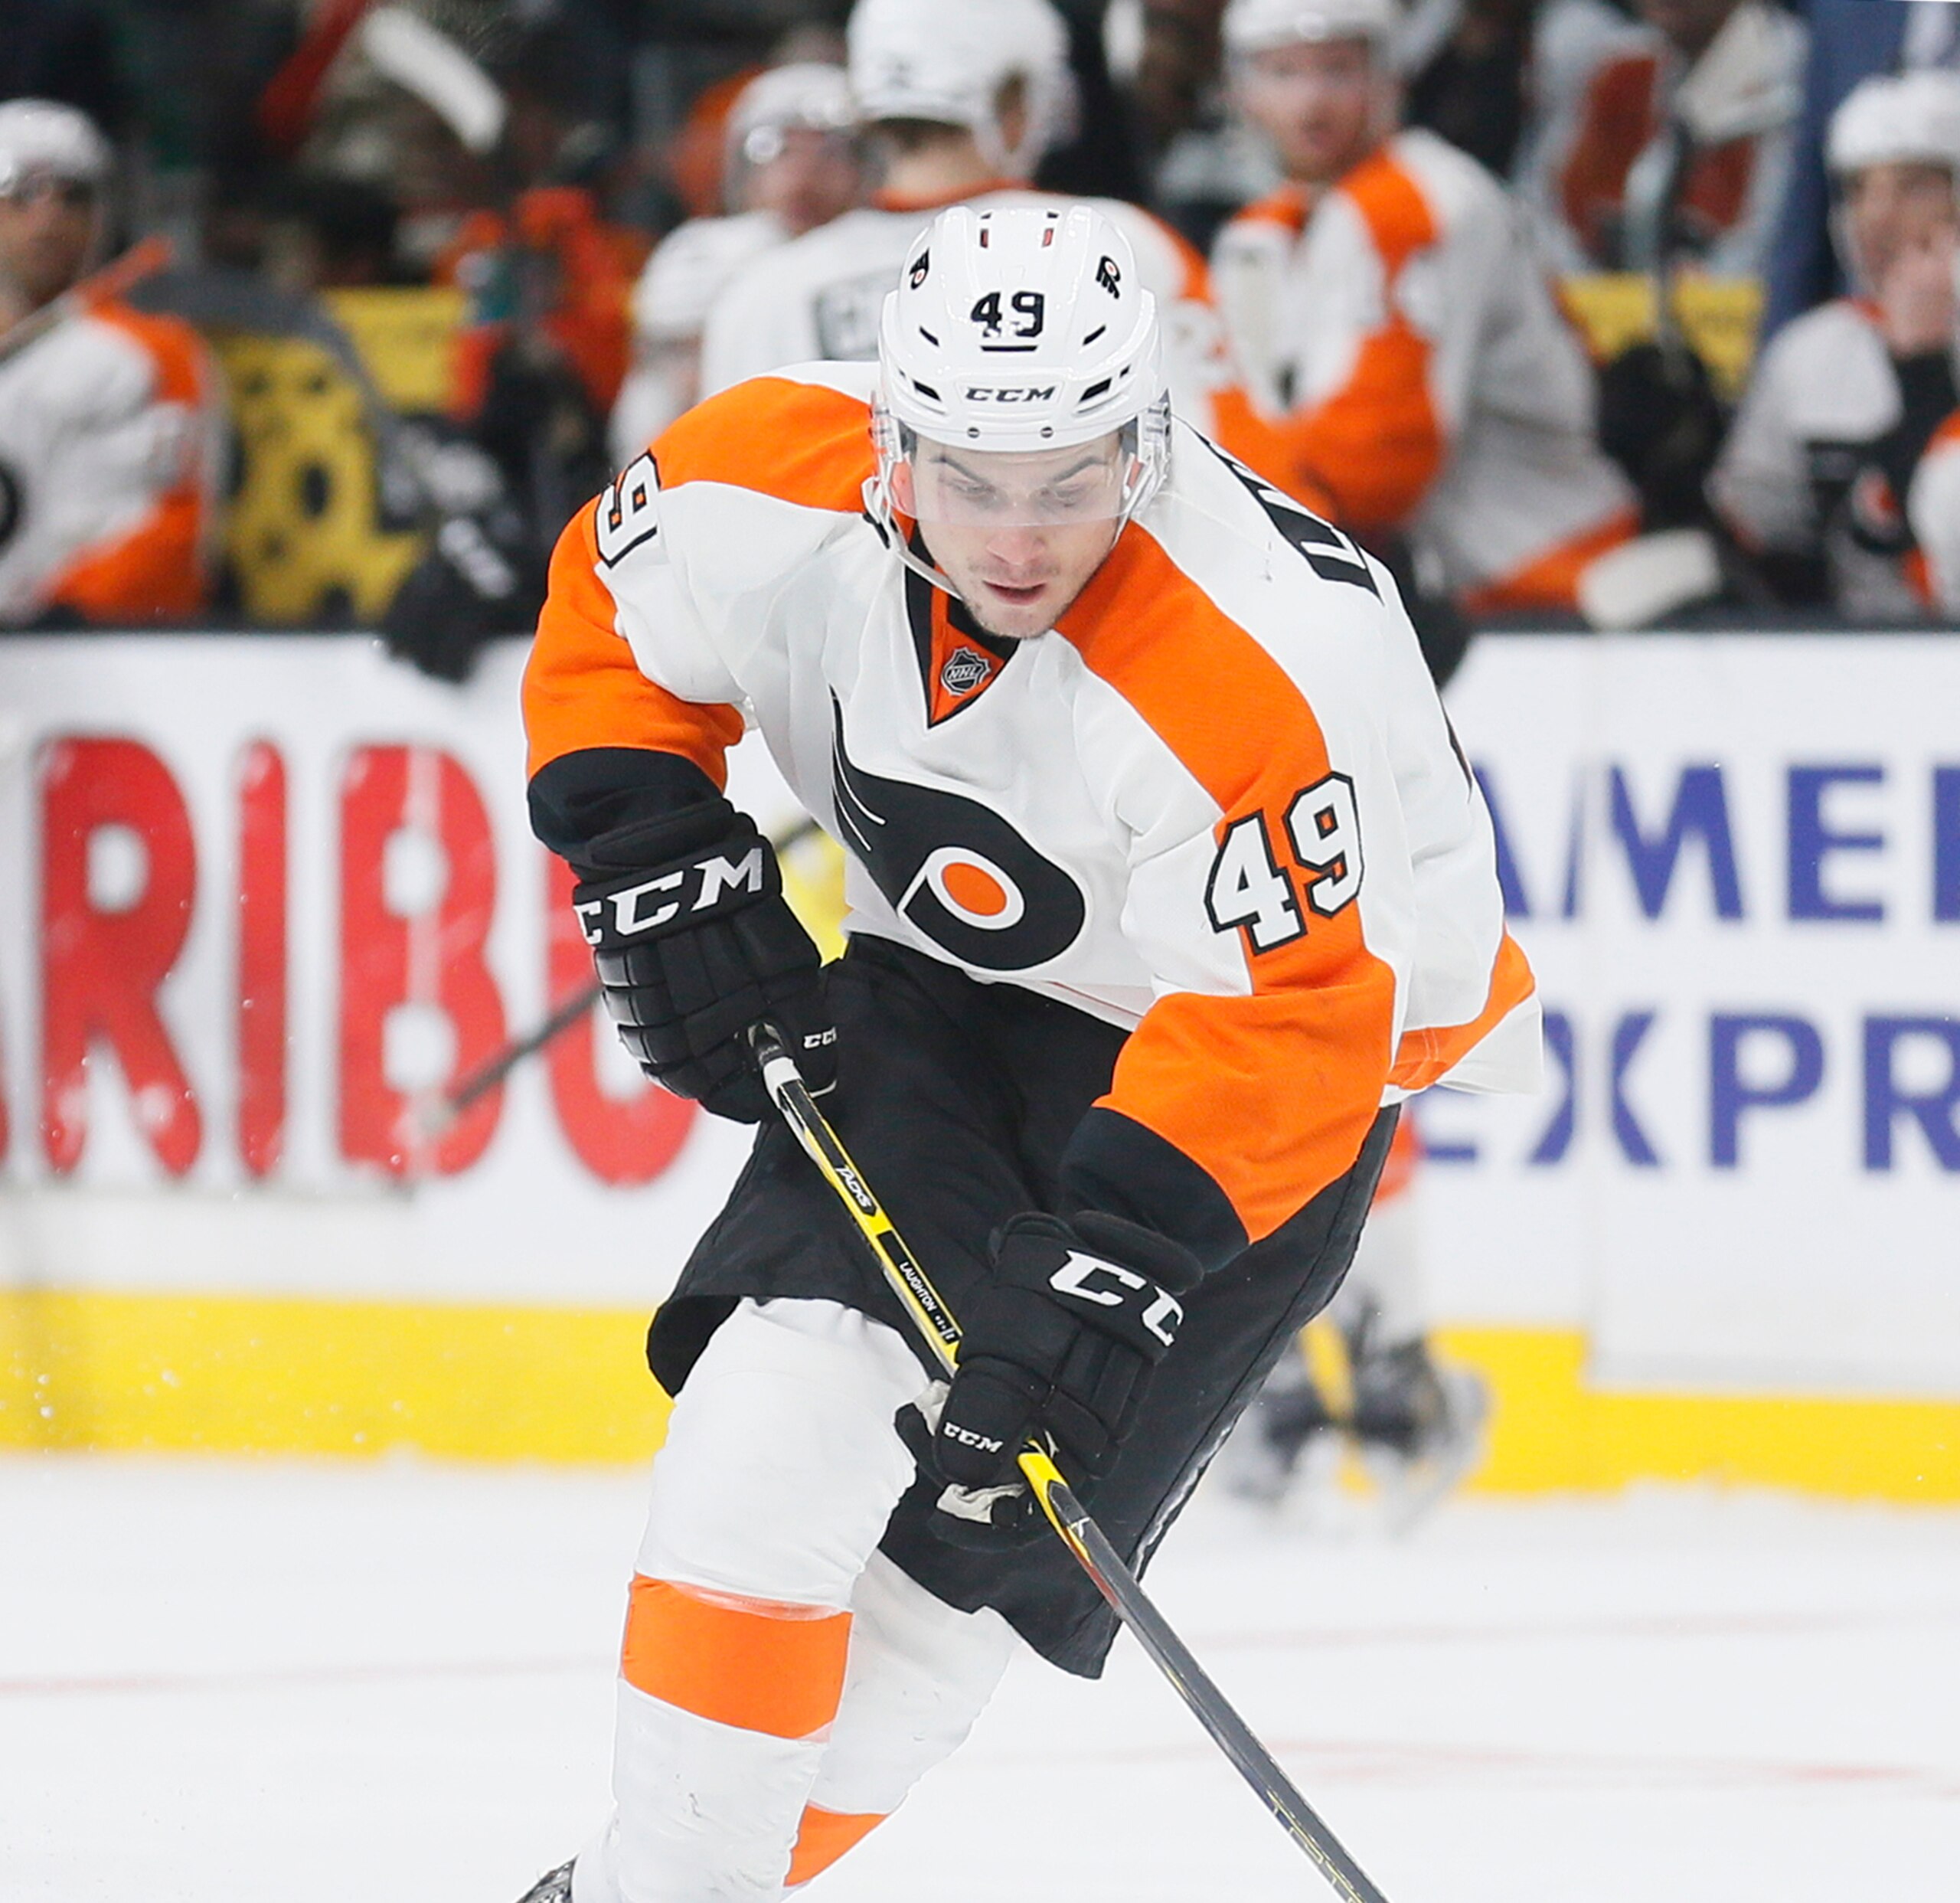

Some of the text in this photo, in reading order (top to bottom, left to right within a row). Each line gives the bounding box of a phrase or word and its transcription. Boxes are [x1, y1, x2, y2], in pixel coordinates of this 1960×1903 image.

[970, 291, 1044, 338] 49
[965, 386, 1056, 402] CCM
[1204, 770, 1365, 956] 49
[1472, 762, 1960, 921] ME
[573, 847, 763, 945] CCM
[0, 734, 702, 1187] RIBO
[835, 1165, 874, 1209] TACKS
[899, 1260, 938, 1313] LAUGHTON
[942, 1421, 1004, 1453] CCM
